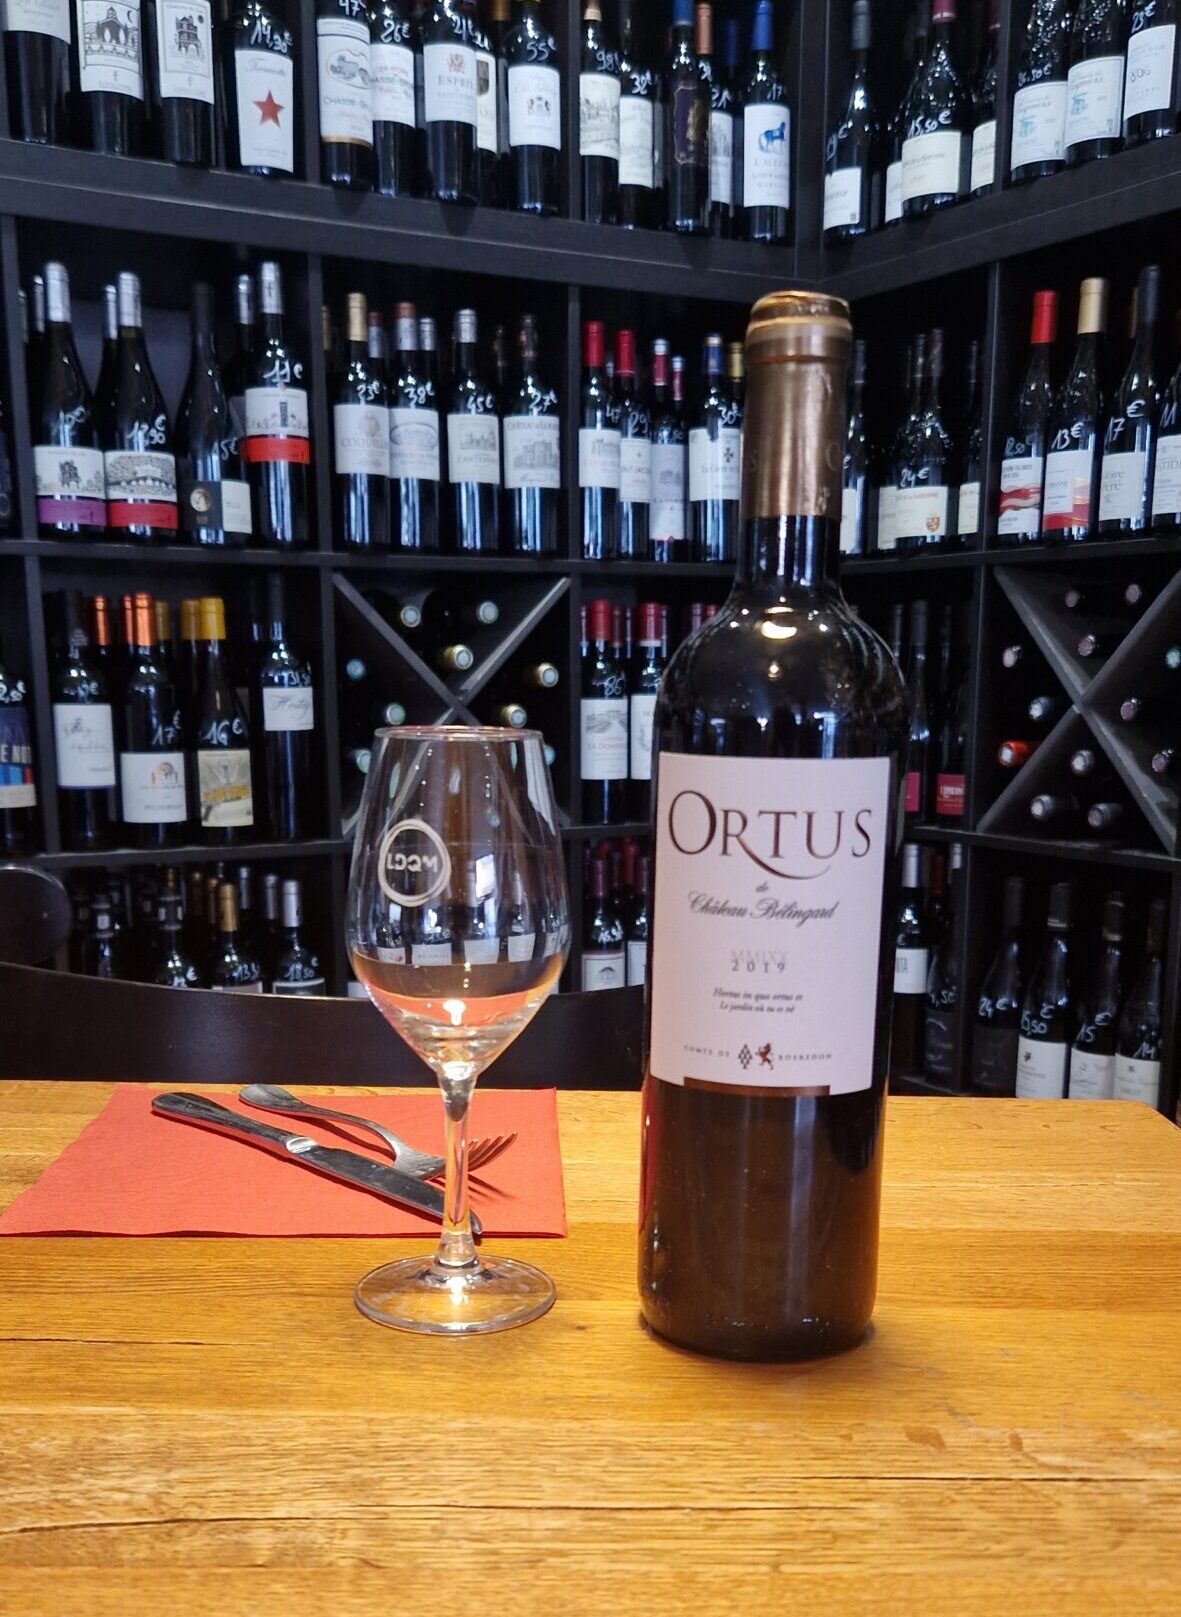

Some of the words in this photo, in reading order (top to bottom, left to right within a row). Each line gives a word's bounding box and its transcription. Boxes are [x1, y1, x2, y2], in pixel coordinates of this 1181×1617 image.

[668, 790, 872, 880] ORTUS
[688, 891, 749, 919] Château
[731, 959, 786, 974] 2019
